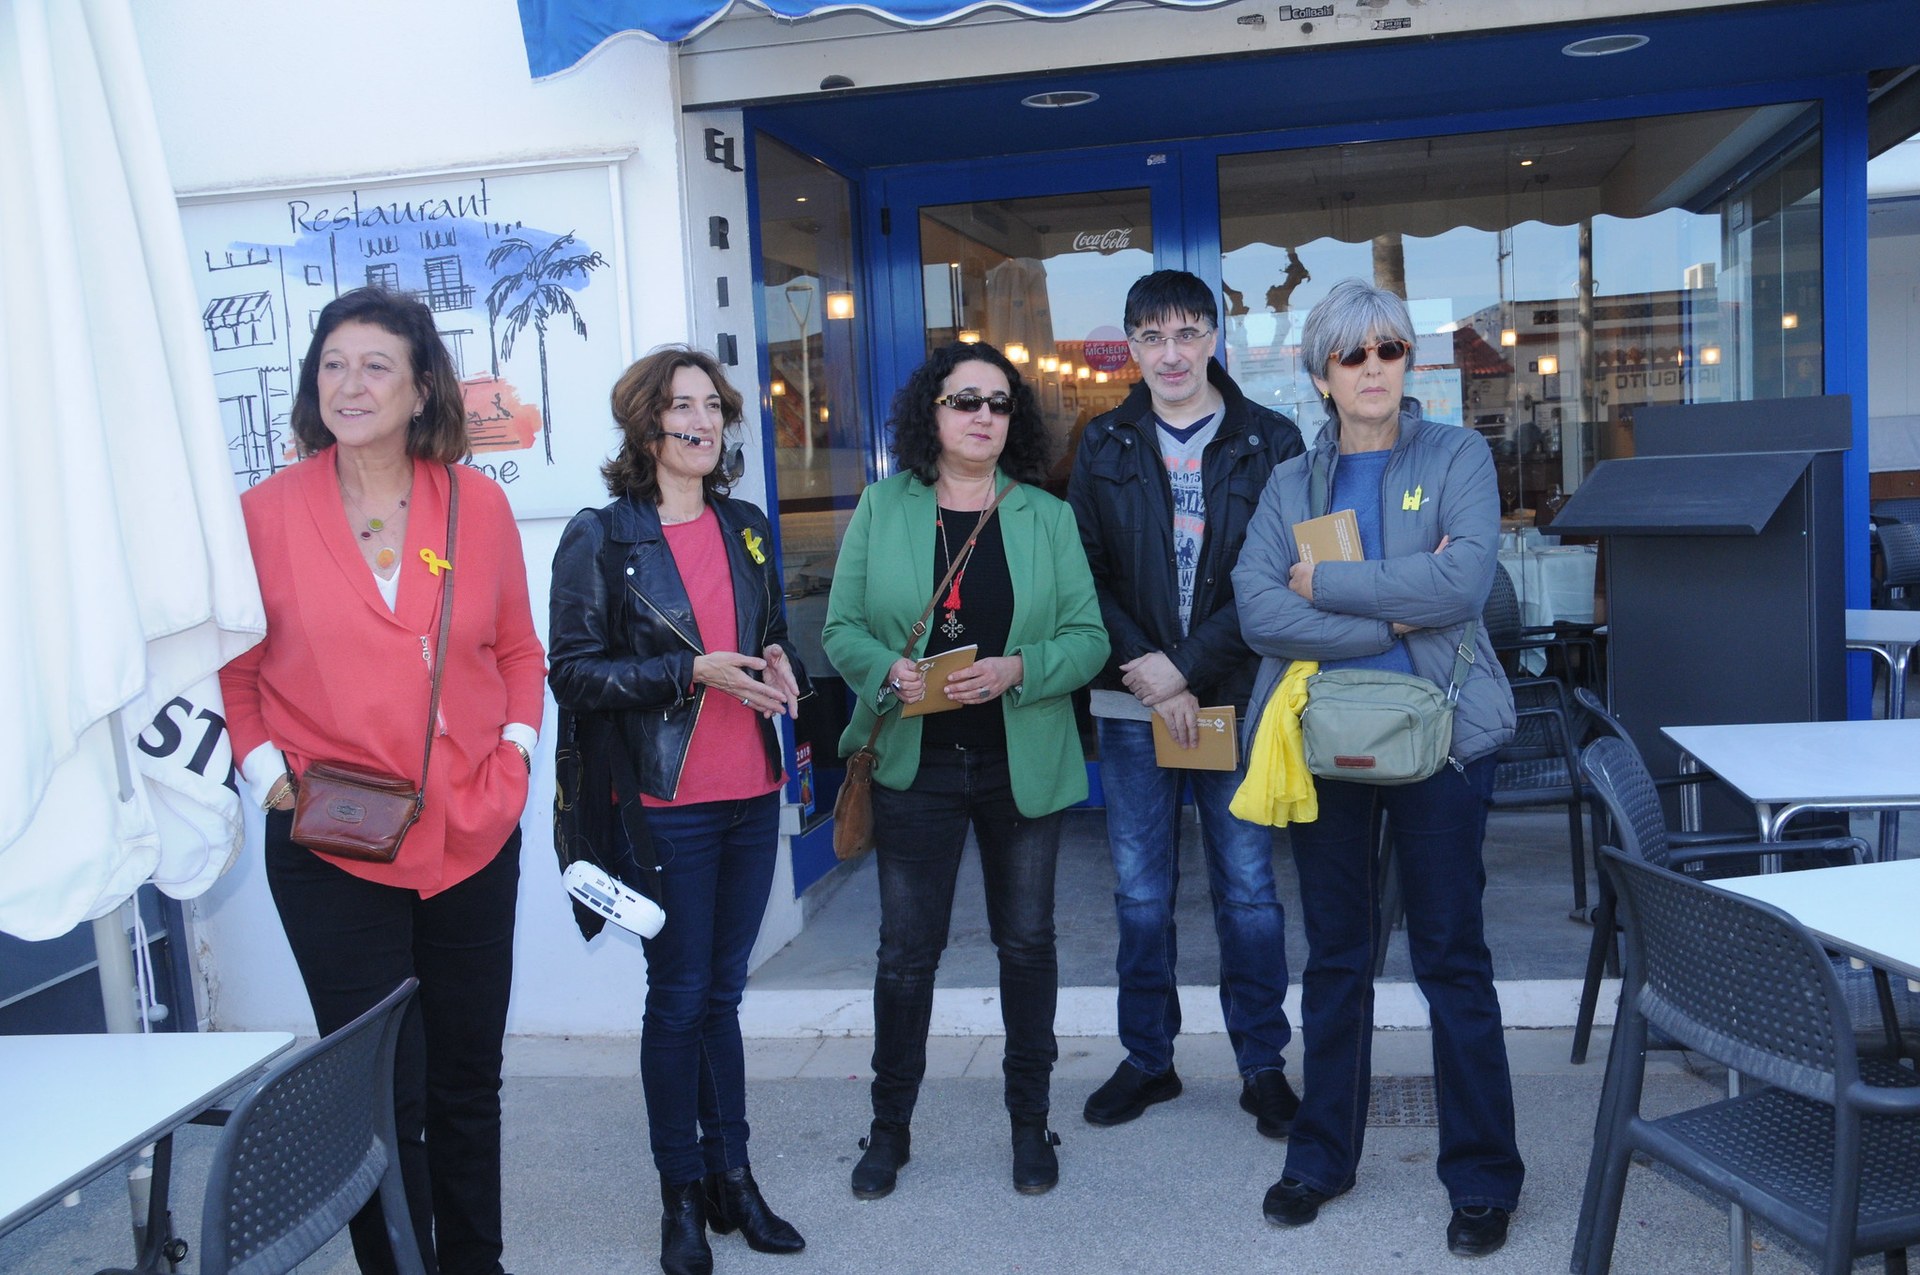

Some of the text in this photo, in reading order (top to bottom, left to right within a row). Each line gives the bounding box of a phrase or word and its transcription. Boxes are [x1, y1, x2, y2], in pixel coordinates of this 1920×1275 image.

[705, 127, 744, 172] EL
[288, 178, 491, 233] Restaurant
[1072, 228, 1133, 251] Coca-Cola
[1085, 345, 1128, 356] MICHELIN
[137, 695, 241, 798] ST
